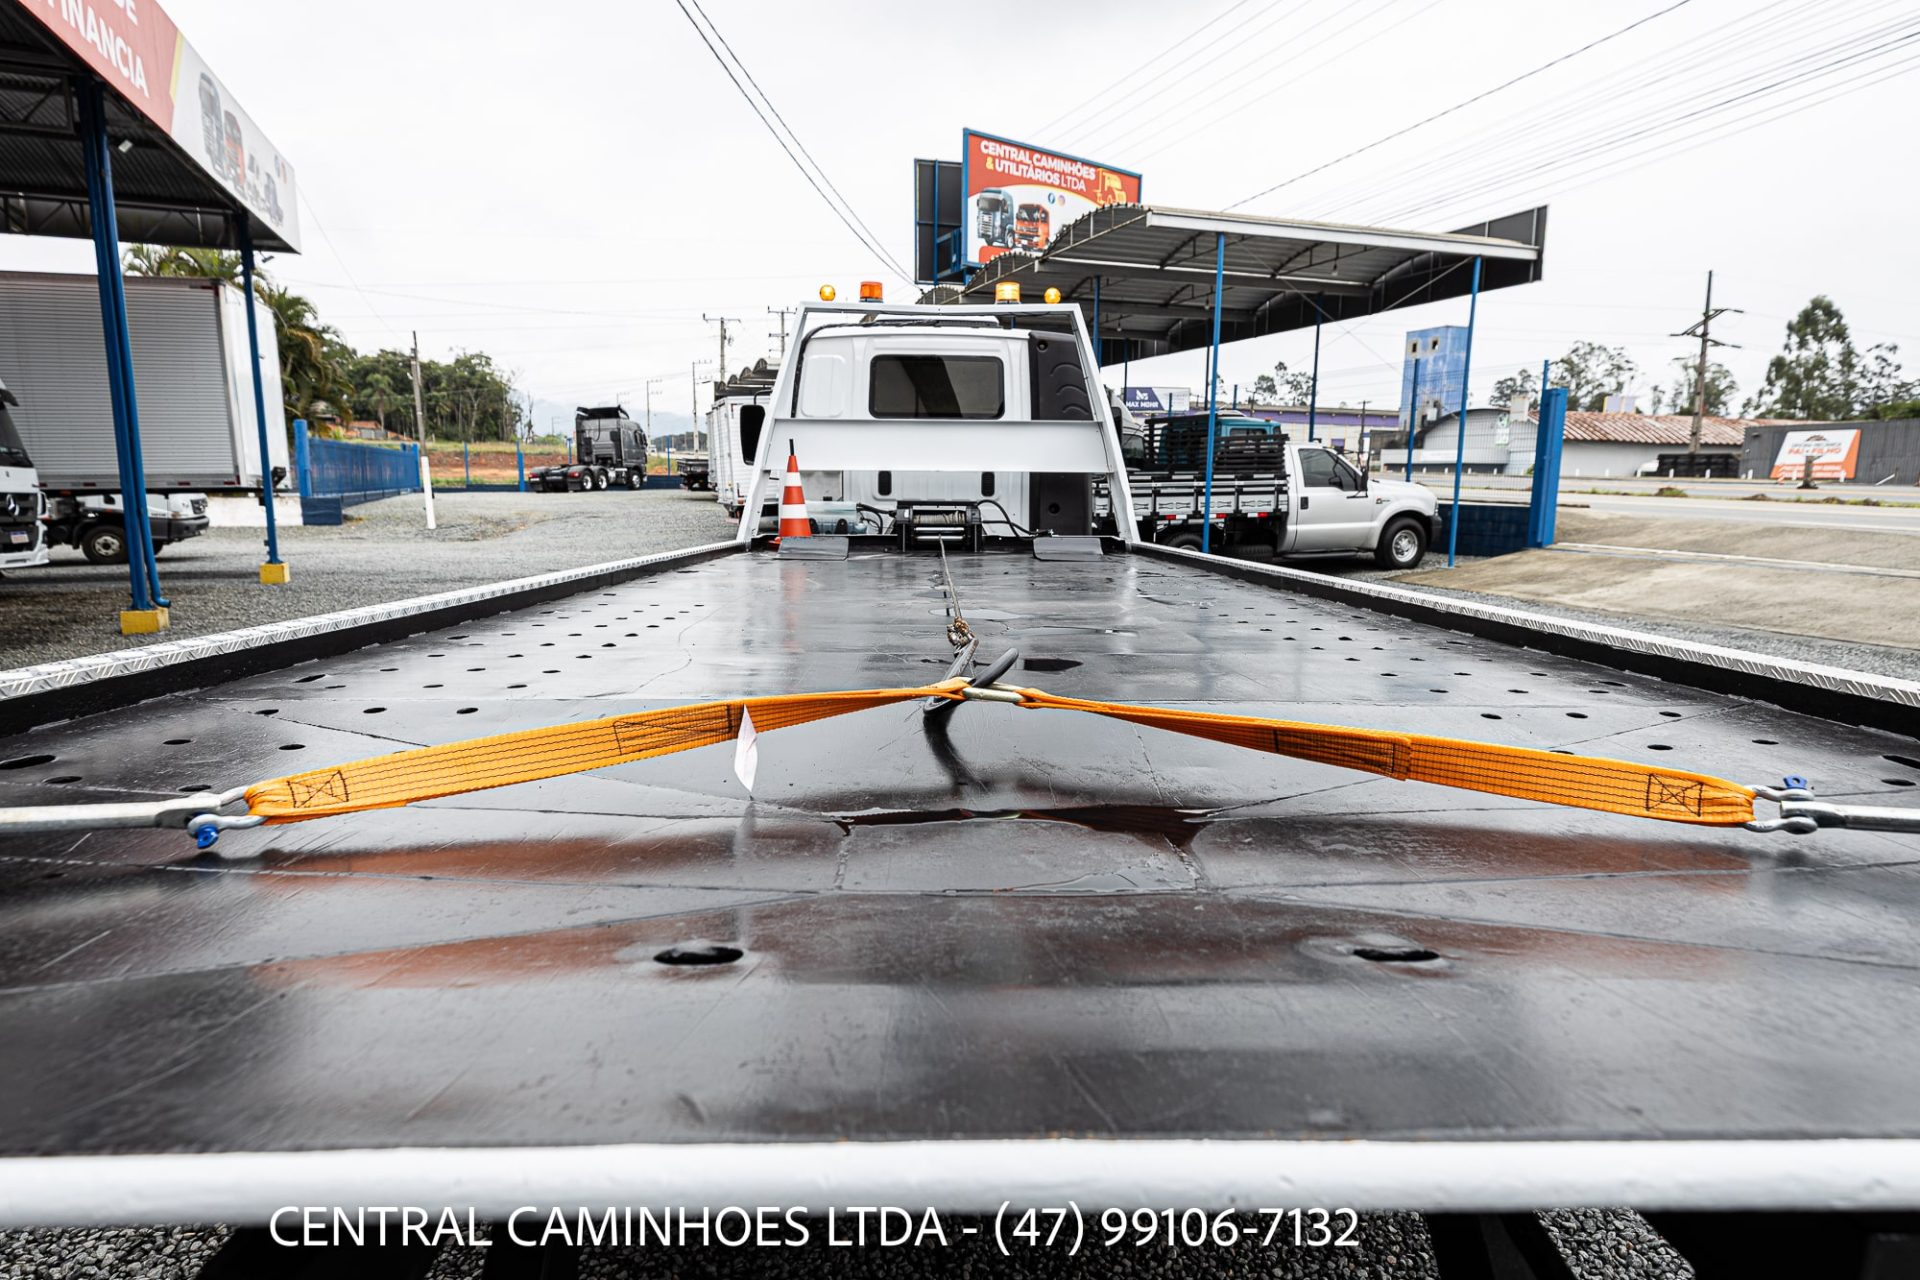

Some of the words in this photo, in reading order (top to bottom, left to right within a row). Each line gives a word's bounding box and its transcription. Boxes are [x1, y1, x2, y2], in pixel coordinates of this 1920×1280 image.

[47, 0, 150, 98] INANCIA
[980, 141, 1032, 164] CENTRAL
[1033, 153, 1096, 181] CAMINHÕES
[986, 157, 994, 170] &
[995, 159, 1060, 185] UTILITÁRIOS
[1060, 174, 1087, 192] LTDA
